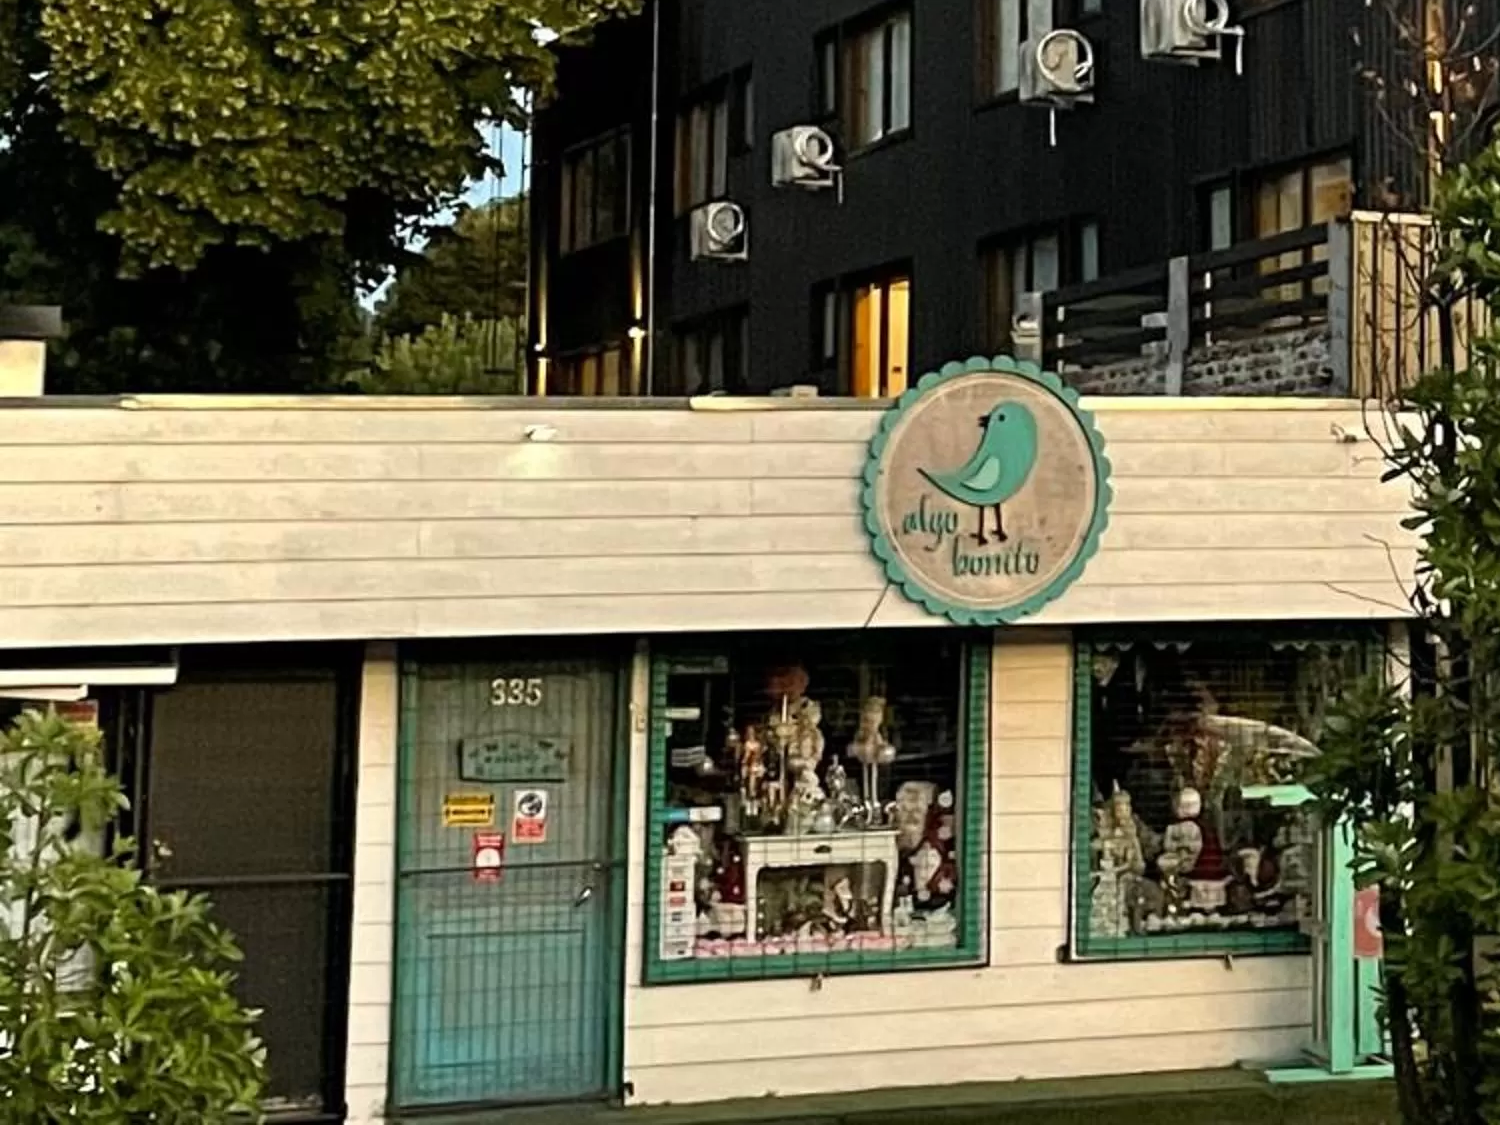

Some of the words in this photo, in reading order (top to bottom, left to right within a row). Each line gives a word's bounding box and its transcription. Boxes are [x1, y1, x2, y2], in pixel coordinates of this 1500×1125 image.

[902, 493, 959, 553] algo
[951, 533, 1040, 577] bonito
[491, 678, 543, 707] 335
